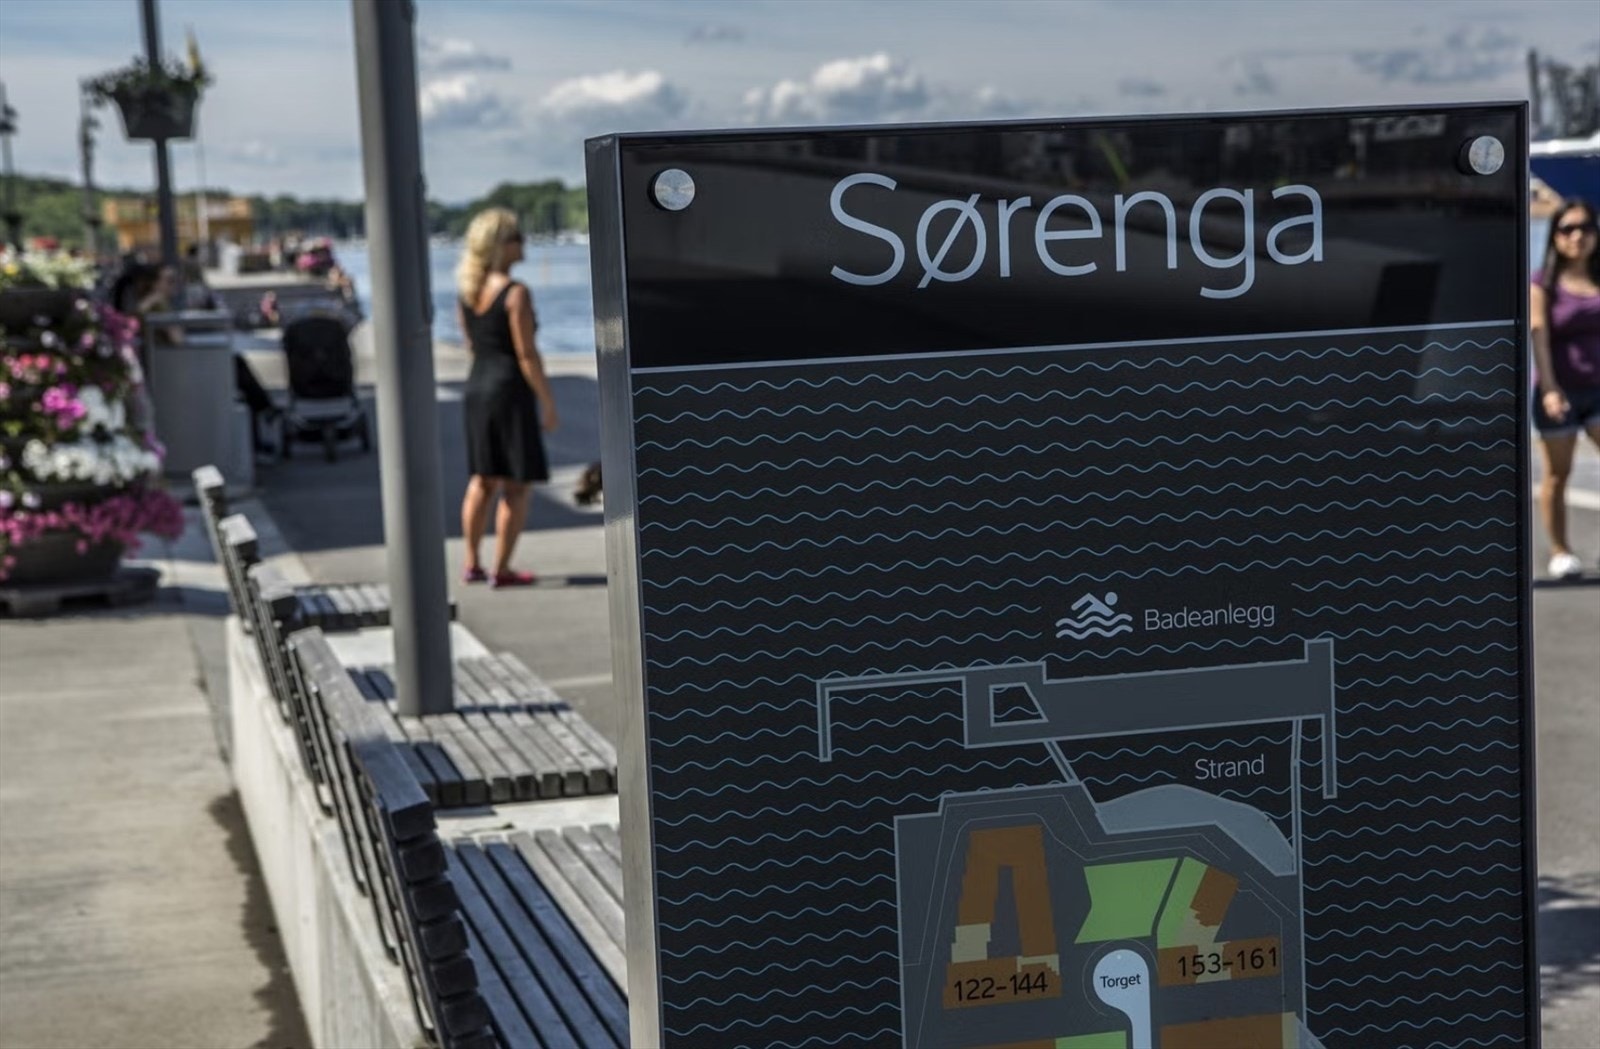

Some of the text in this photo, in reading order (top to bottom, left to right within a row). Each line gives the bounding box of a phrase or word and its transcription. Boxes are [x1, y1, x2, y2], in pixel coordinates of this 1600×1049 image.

[830, 172, 1324, 299] Sørenga
[1144, 603, 1275, 630] Badeanlegg
[1195, 754, 1265, 780] Strand
[1178, 947, 1279, 976] 153-161
[954, 973, 1048, 1001] 122-144
[1100, 973, 1141, 990] Torget
